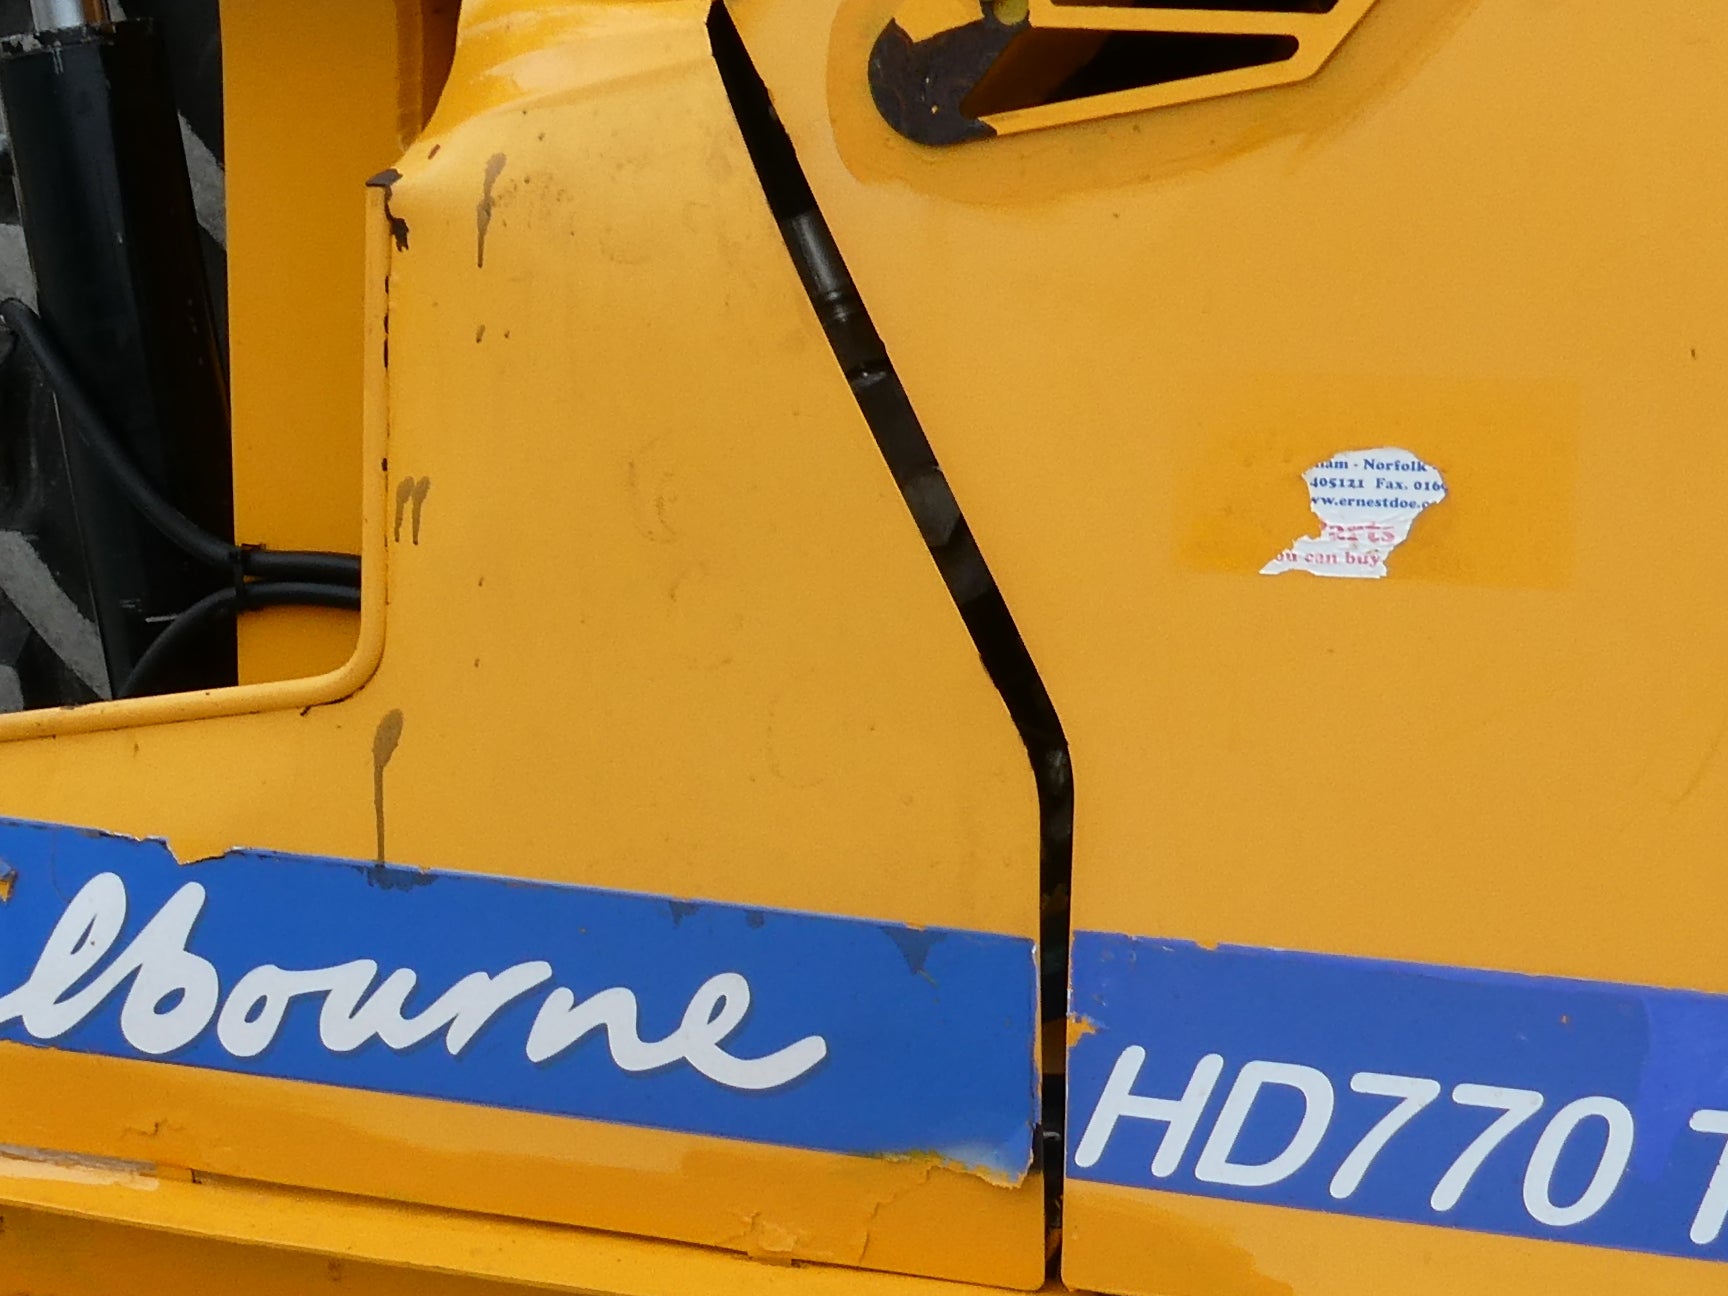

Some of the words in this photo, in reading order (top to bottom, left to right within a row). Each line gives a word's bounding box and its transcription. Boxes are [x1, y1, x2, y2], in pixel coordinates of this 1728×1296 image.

[1363, 458, 1428, 472] Norfolk
[1375, 477, 1408, 491] Fax.
[1304, 552, 1338, 564] can
[1345, 550, 1381, 568] buy
[1073, 1043, 1637, 1228] HD770
